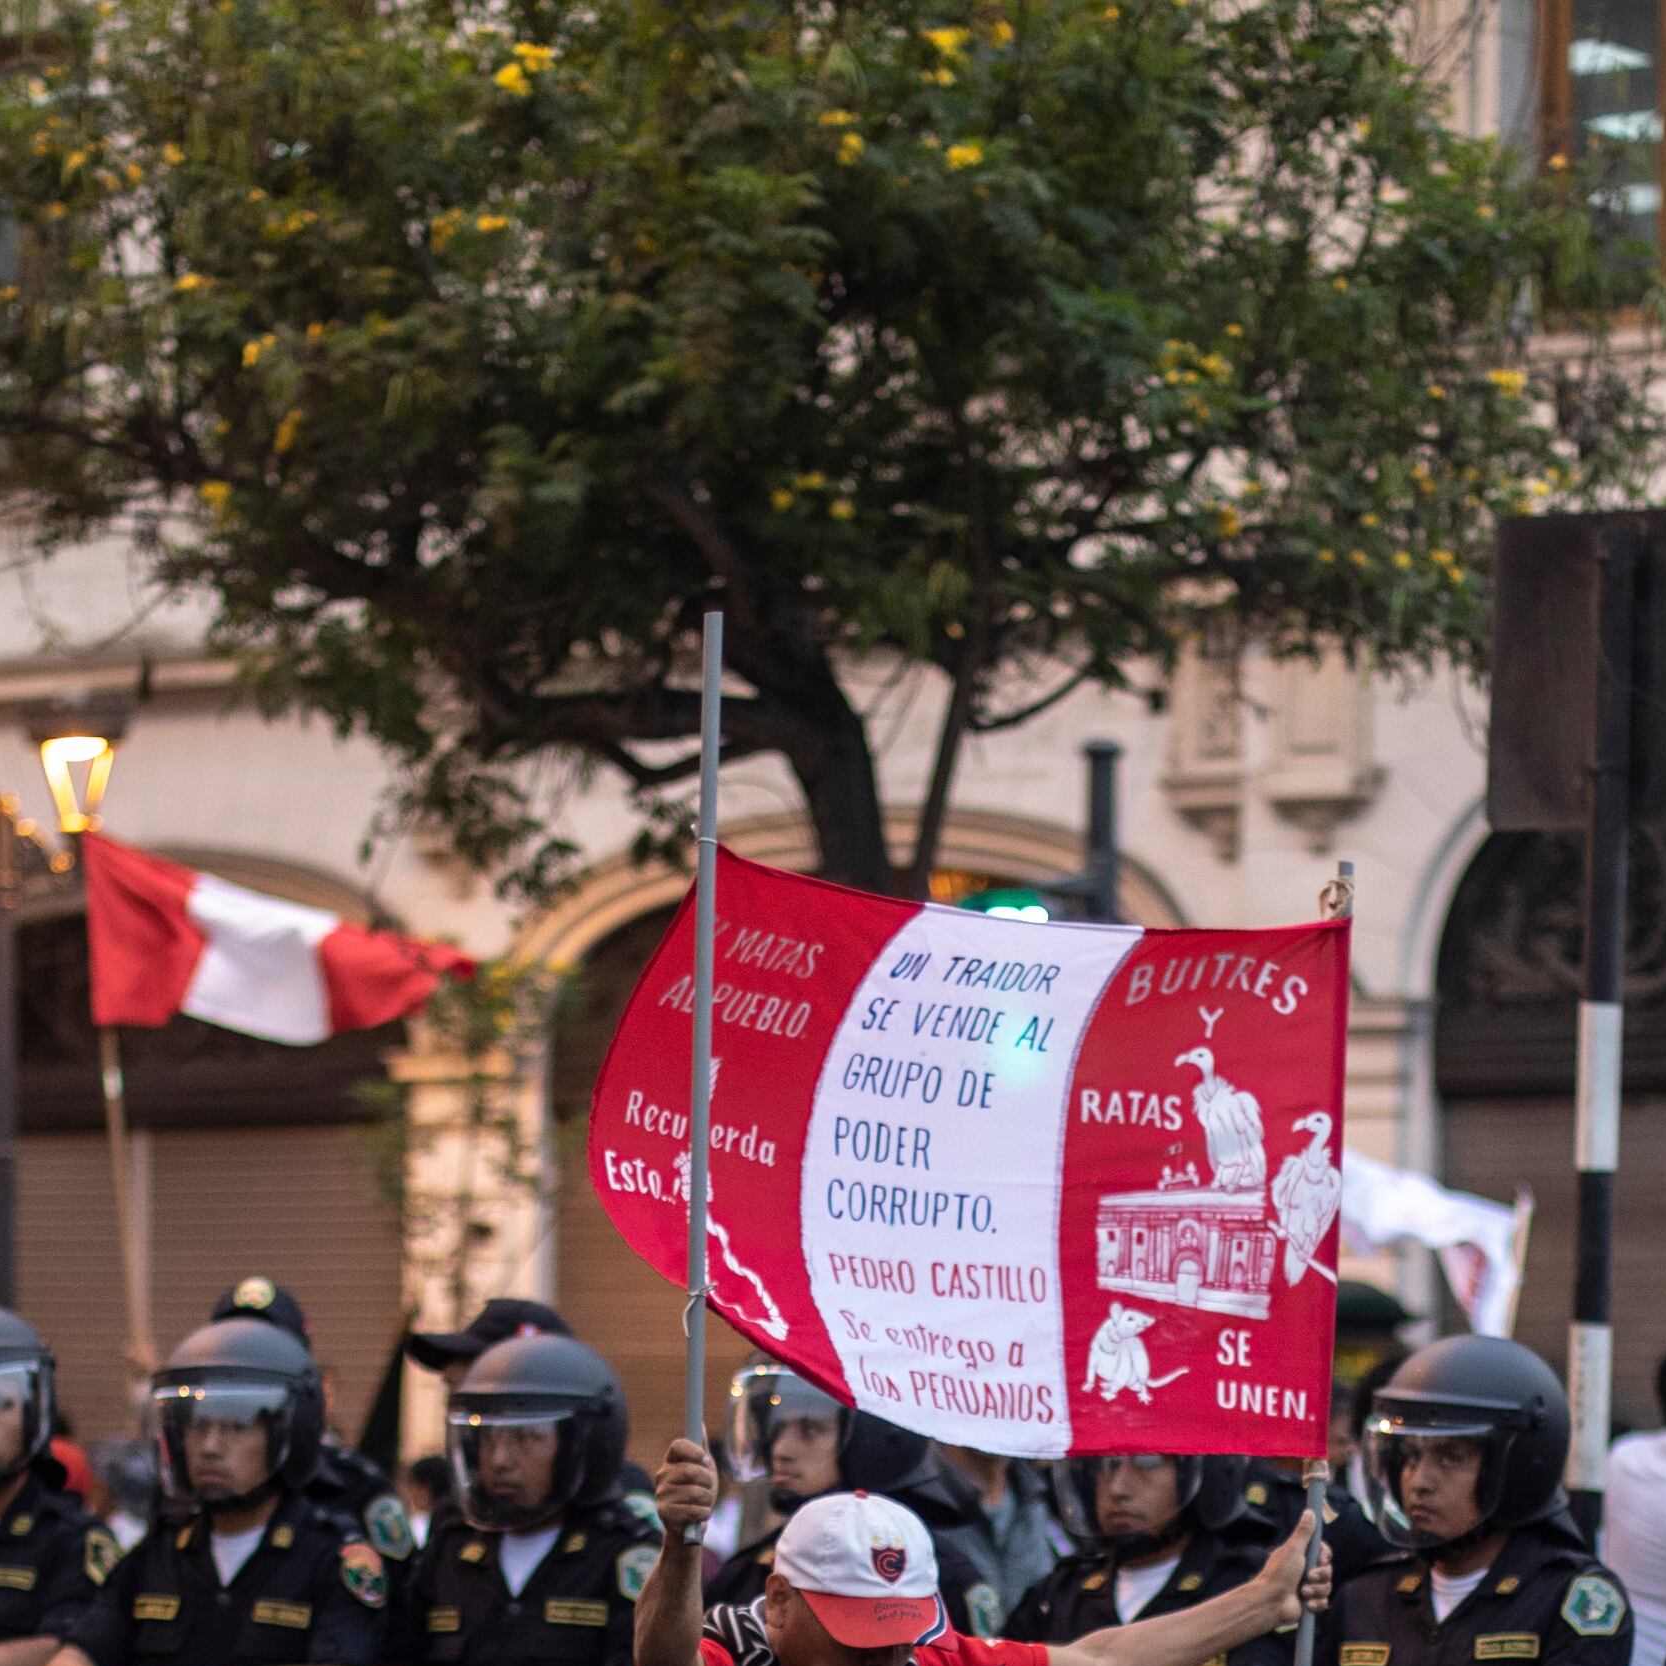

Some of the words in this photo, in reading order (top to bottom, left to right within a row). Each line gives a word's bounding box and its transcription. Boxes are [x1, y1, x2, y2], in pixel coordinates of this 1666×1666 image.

[724, 927, 825, 980] MATAS
[889, 952, 933, 982] UN
[942, 956, 1061, 995] TRAIDOR
[658, 974, 695, 1014] AL
[1125, 952, 1309, 1016] BUITRES
[862, 997, 901, 1032] SE
[913, 1002, 1007, 1045] VENDE
[1015, 1016, 1055, 1052] AL
[1198, 1005, 1225, 1039] Y
[842, 1053, 943, 1105] GRUPO
[957, 1069, 996, 1109] DE
[624, 1091, 777, 1168] Recuerda
[1080, 1088, 1183, 1131] RATAS
[834, 1116, 931, 1171] PODER
[827, 1178, 997, 1234] CORRUPTO.
[828, 1252, 916, 1295] PEDRO
[931, 1261, 1047, 1304] CASTILLO
[839, 1309, 878, 1344] Se
[885, 1323, 996, 1371] entrego
[1008, 1340, 1025, 1369] a
[1216, 1327, 1253, 1368] SE
[859, 1355, 903, 1403] los
[1216, 1380, 1316, 1421] UNEN.
